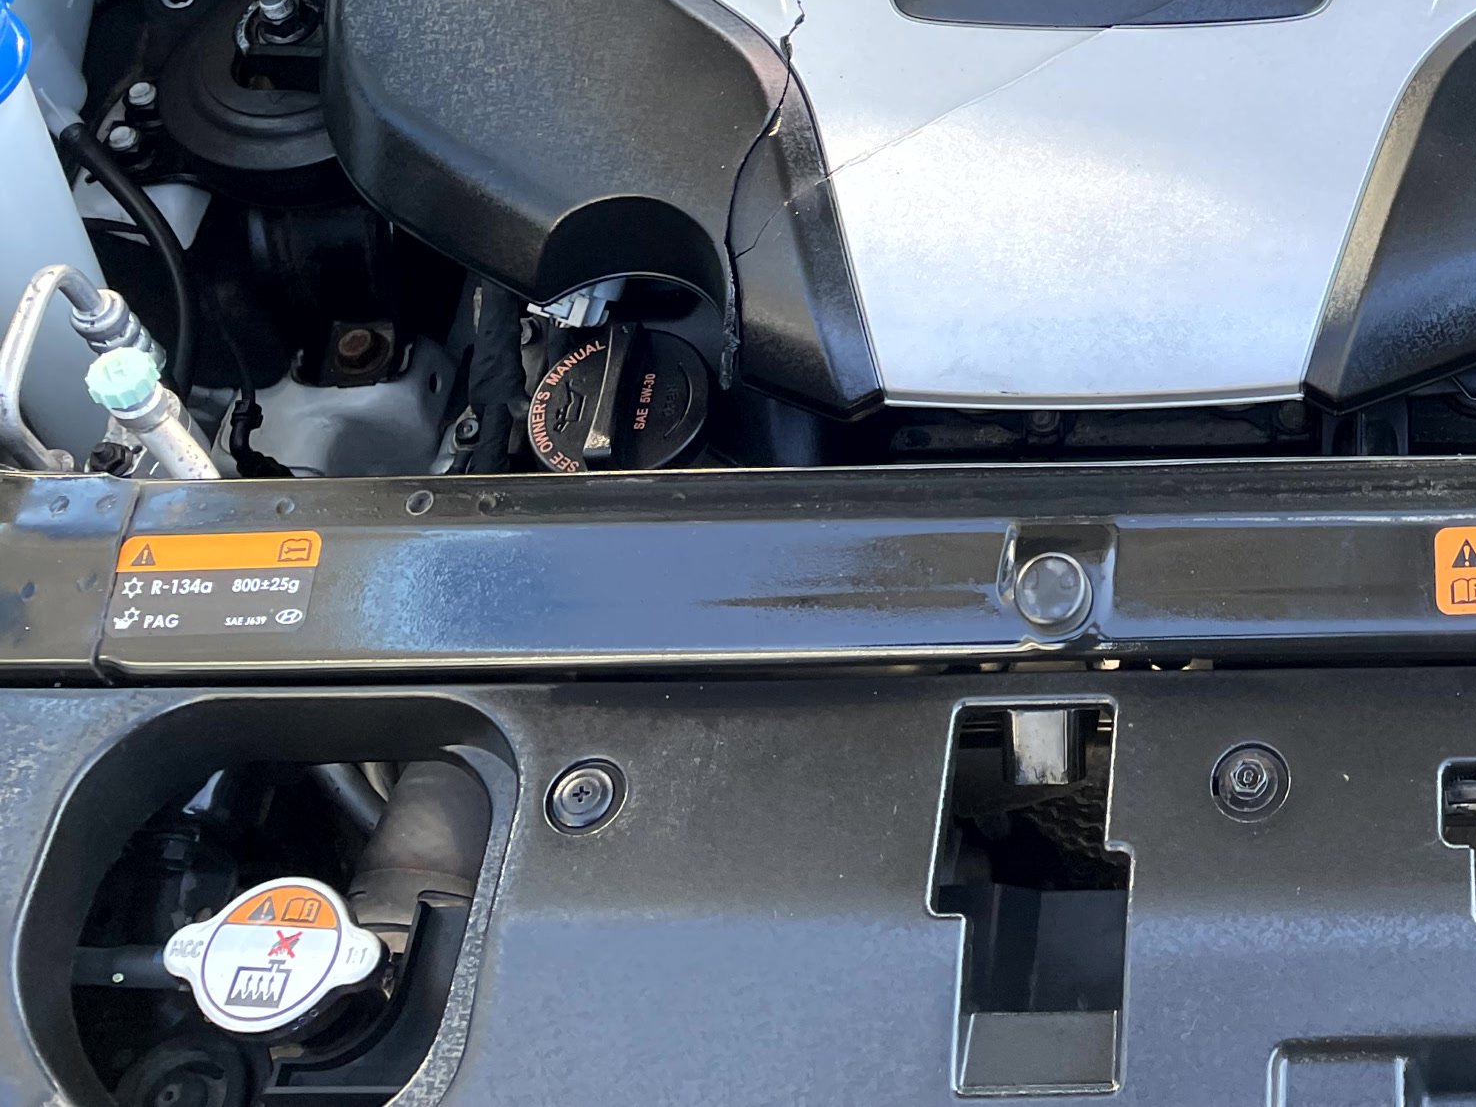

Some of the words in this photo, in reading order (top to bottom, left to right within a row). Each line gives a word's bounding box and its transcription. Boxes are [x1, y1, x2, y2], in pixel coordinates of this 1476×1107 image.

[545, 340, 606, 386] MANUAL
[531, 391, 553, 453] OWNER'S
[633, 407, 649, 430] SAE
[550, 451, 580, 472] SEE
[151, 579, 213, 595] R-134a
[231, 578, 300, 594] 800±25g
[143, 614, 179, 629] PAG
[224, 617, 243, 626] SAE
[244, 616, 267, 626] J639
